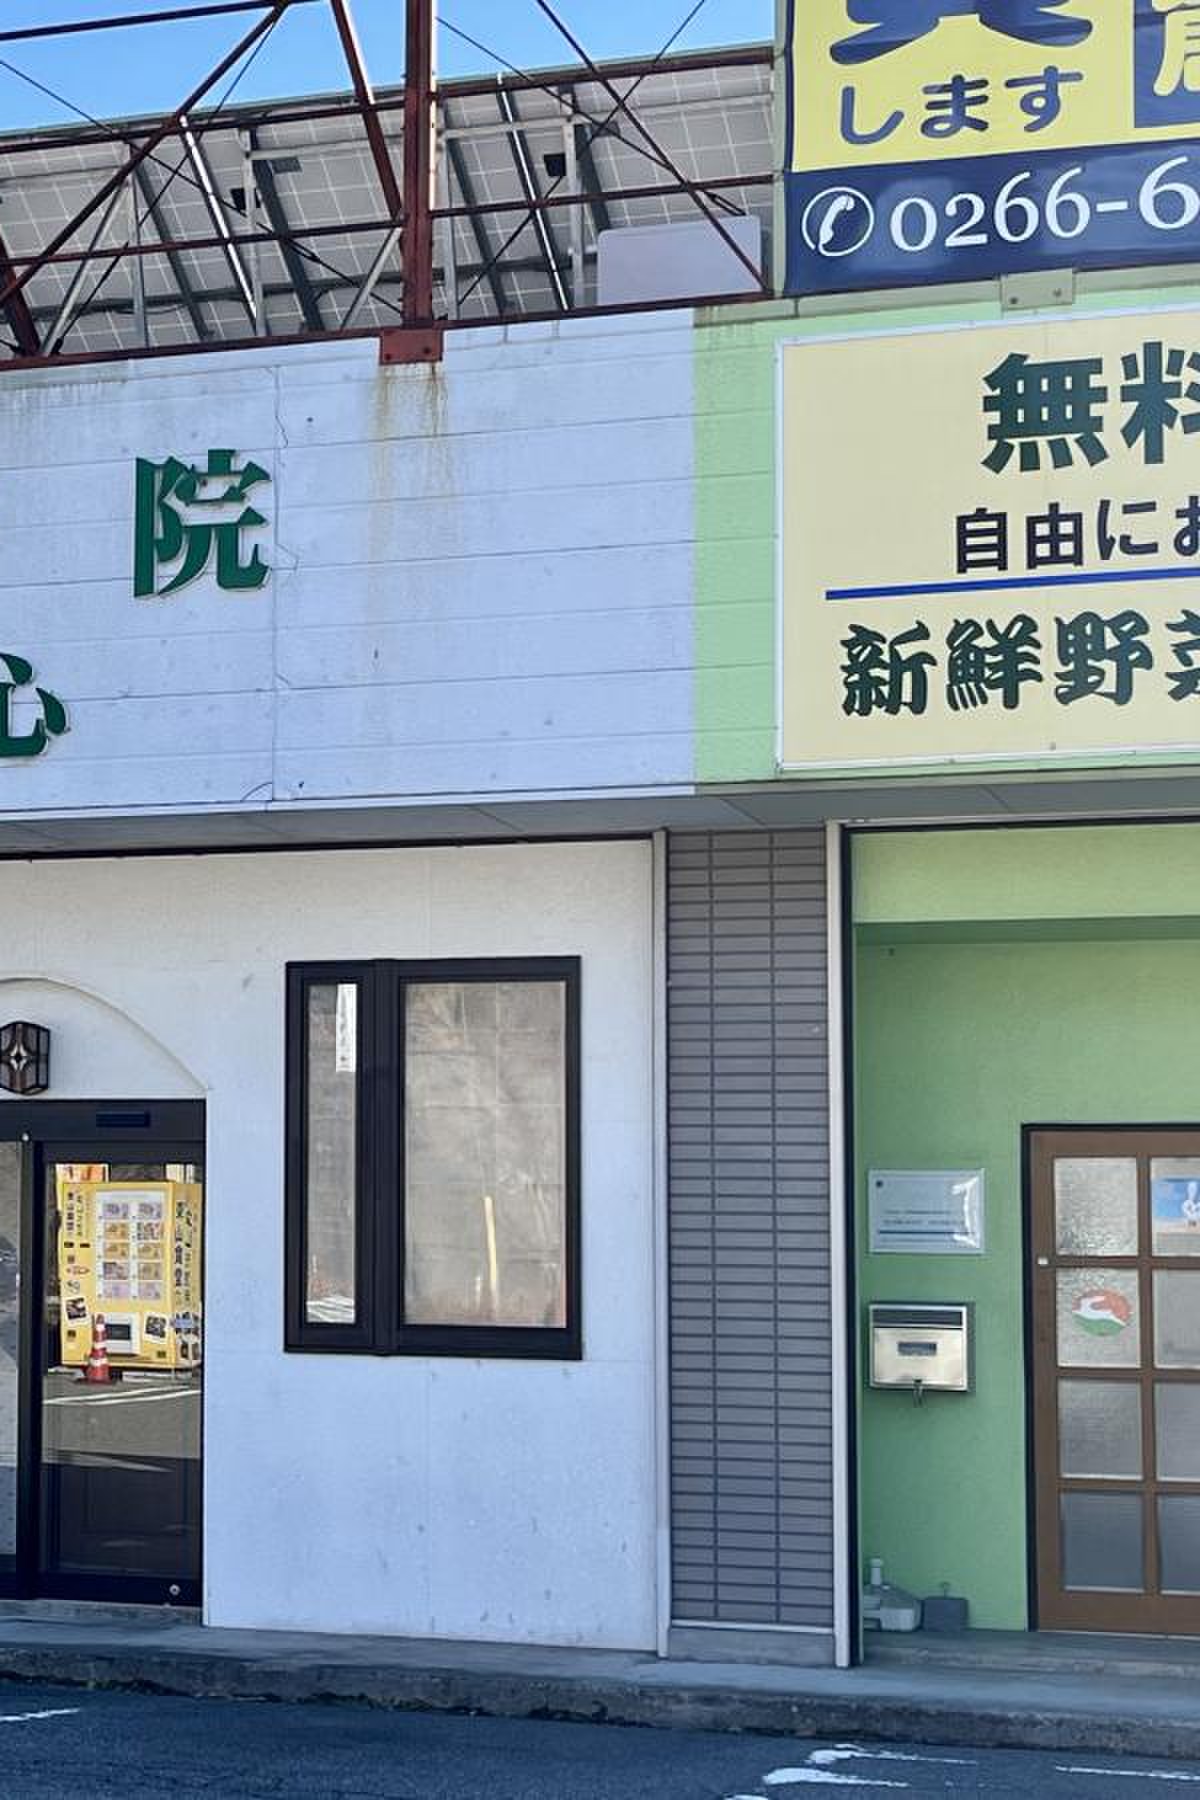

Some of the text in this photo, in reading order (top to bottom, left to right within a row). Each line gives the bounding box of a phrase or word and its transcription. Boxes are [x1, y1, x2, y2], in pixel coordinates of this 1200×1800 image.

[840, 65, 1083, 145] します
[889, 156, 1200, 252] 0266-6
